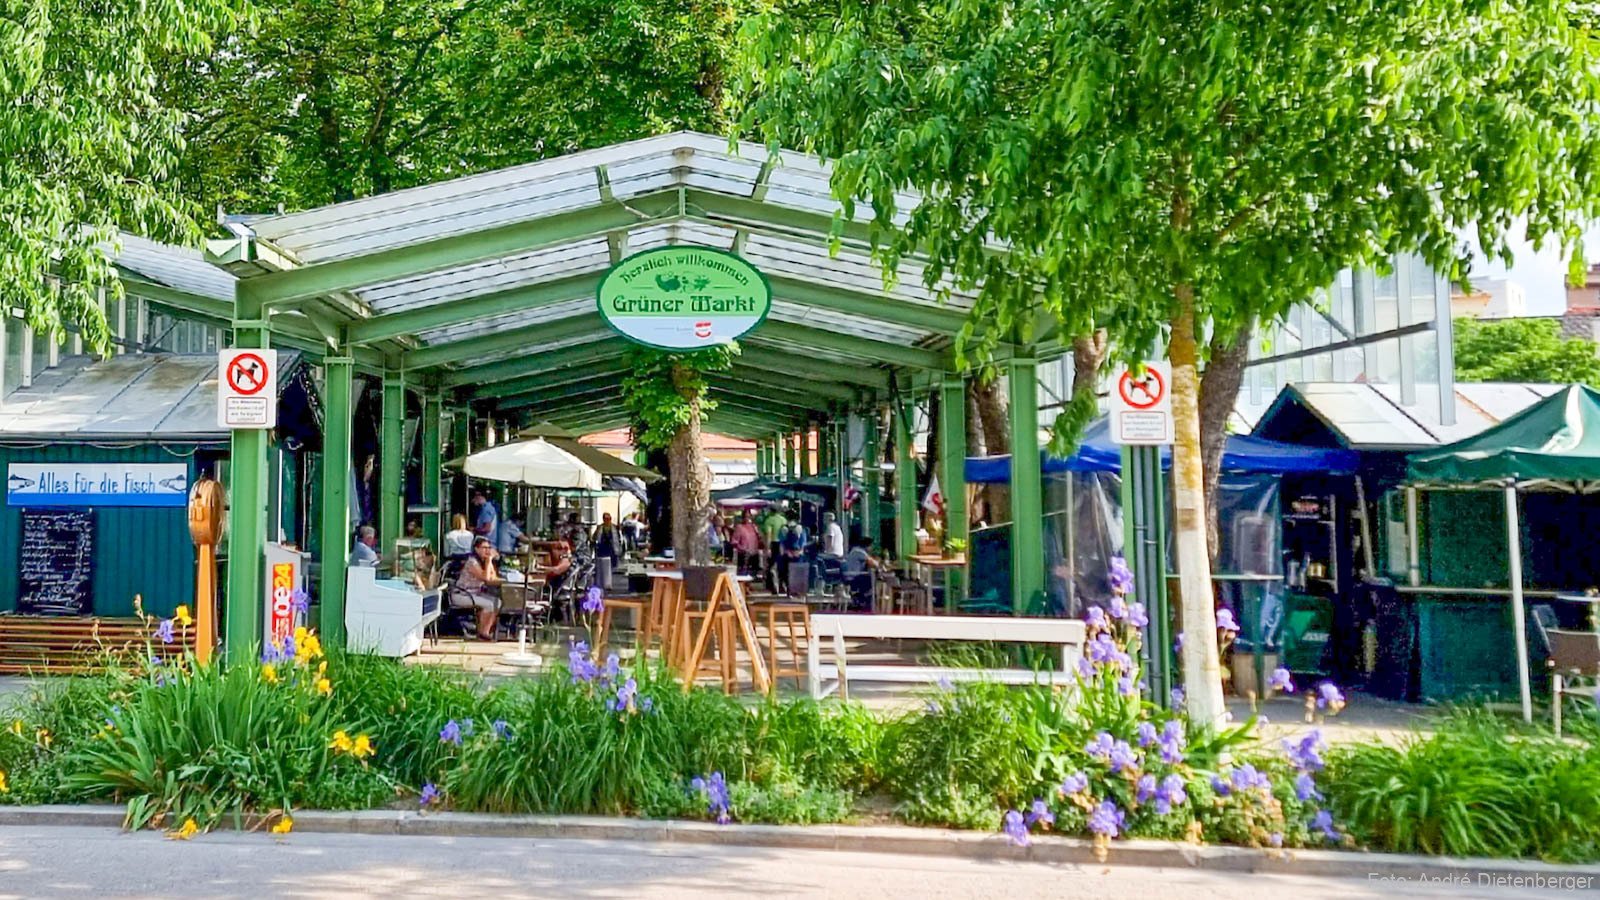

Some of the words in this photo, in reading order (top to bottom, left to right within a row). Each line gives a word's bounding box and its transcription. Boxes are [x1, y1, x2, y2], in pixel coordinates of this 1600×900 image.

[676, 254, 749, 286] willkommen
[613, 294, 684, 312] Grüner
[690, 295, 756, 312] Markt
[38, 472, 69, 493] Alles
[100, 472, 118, 493] die
[124, 472, 156, 494] Fisch
